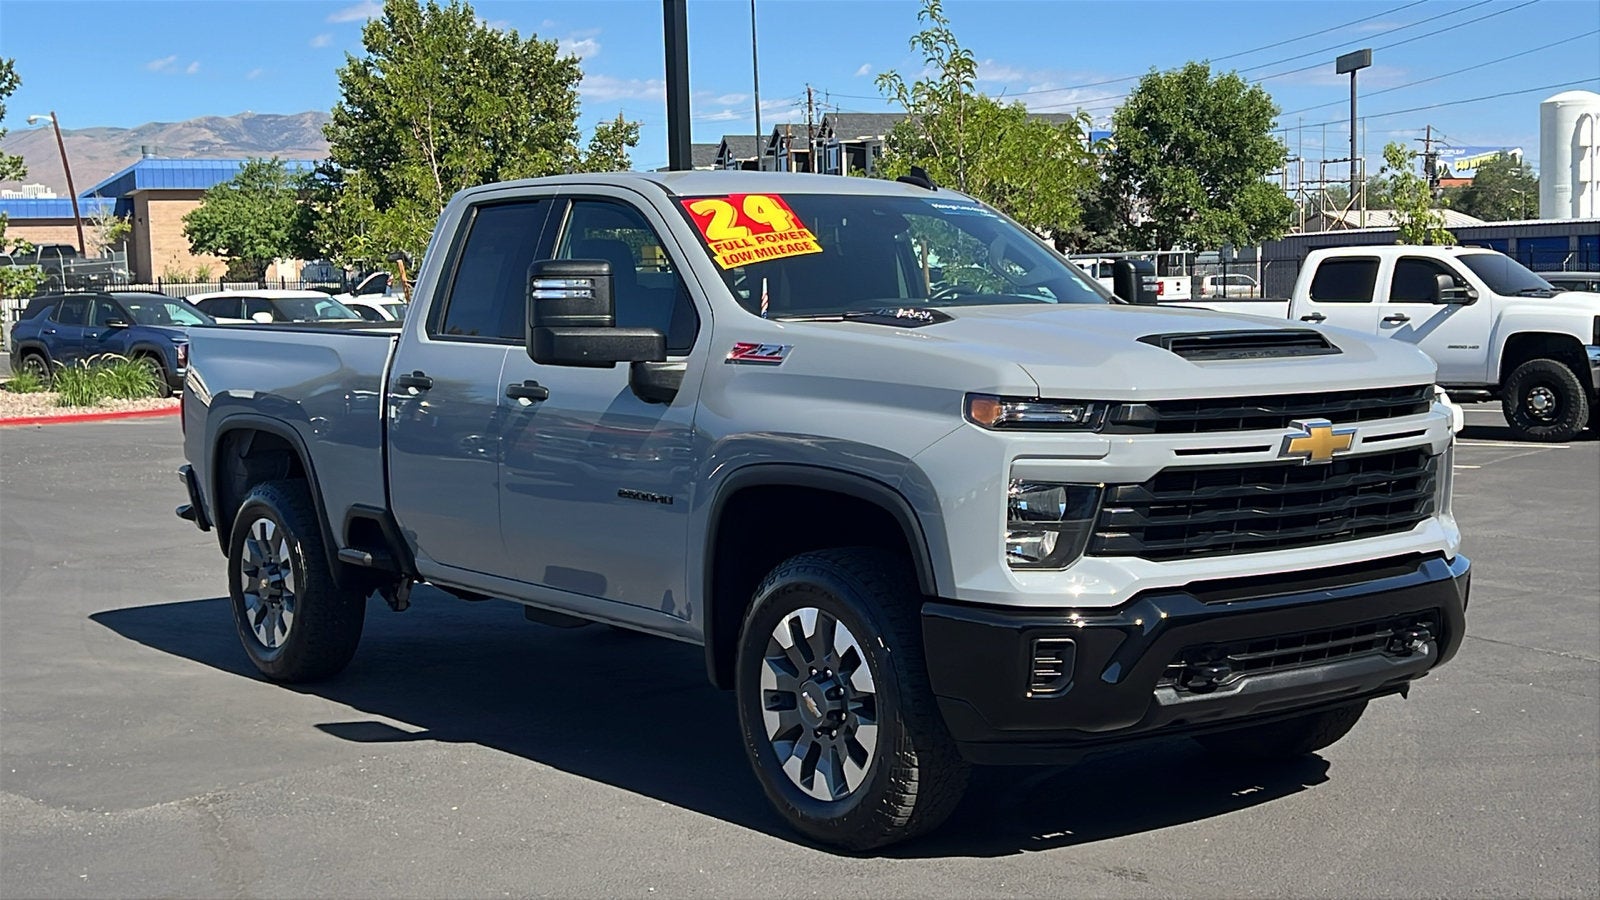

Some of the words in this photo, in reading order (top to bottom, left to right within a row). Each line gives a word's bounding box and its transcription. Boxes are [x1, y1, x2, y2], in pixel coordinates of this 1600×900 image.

[690, 195, 796, 241] 24
[714, 238, 752, 253] FULL
[755, 230, 809, 246] POWER
[723, 250, 752, 265] LOW
[754, 241, 811, 258] MILEAGE
[725, 342, 794, 366] Z71
